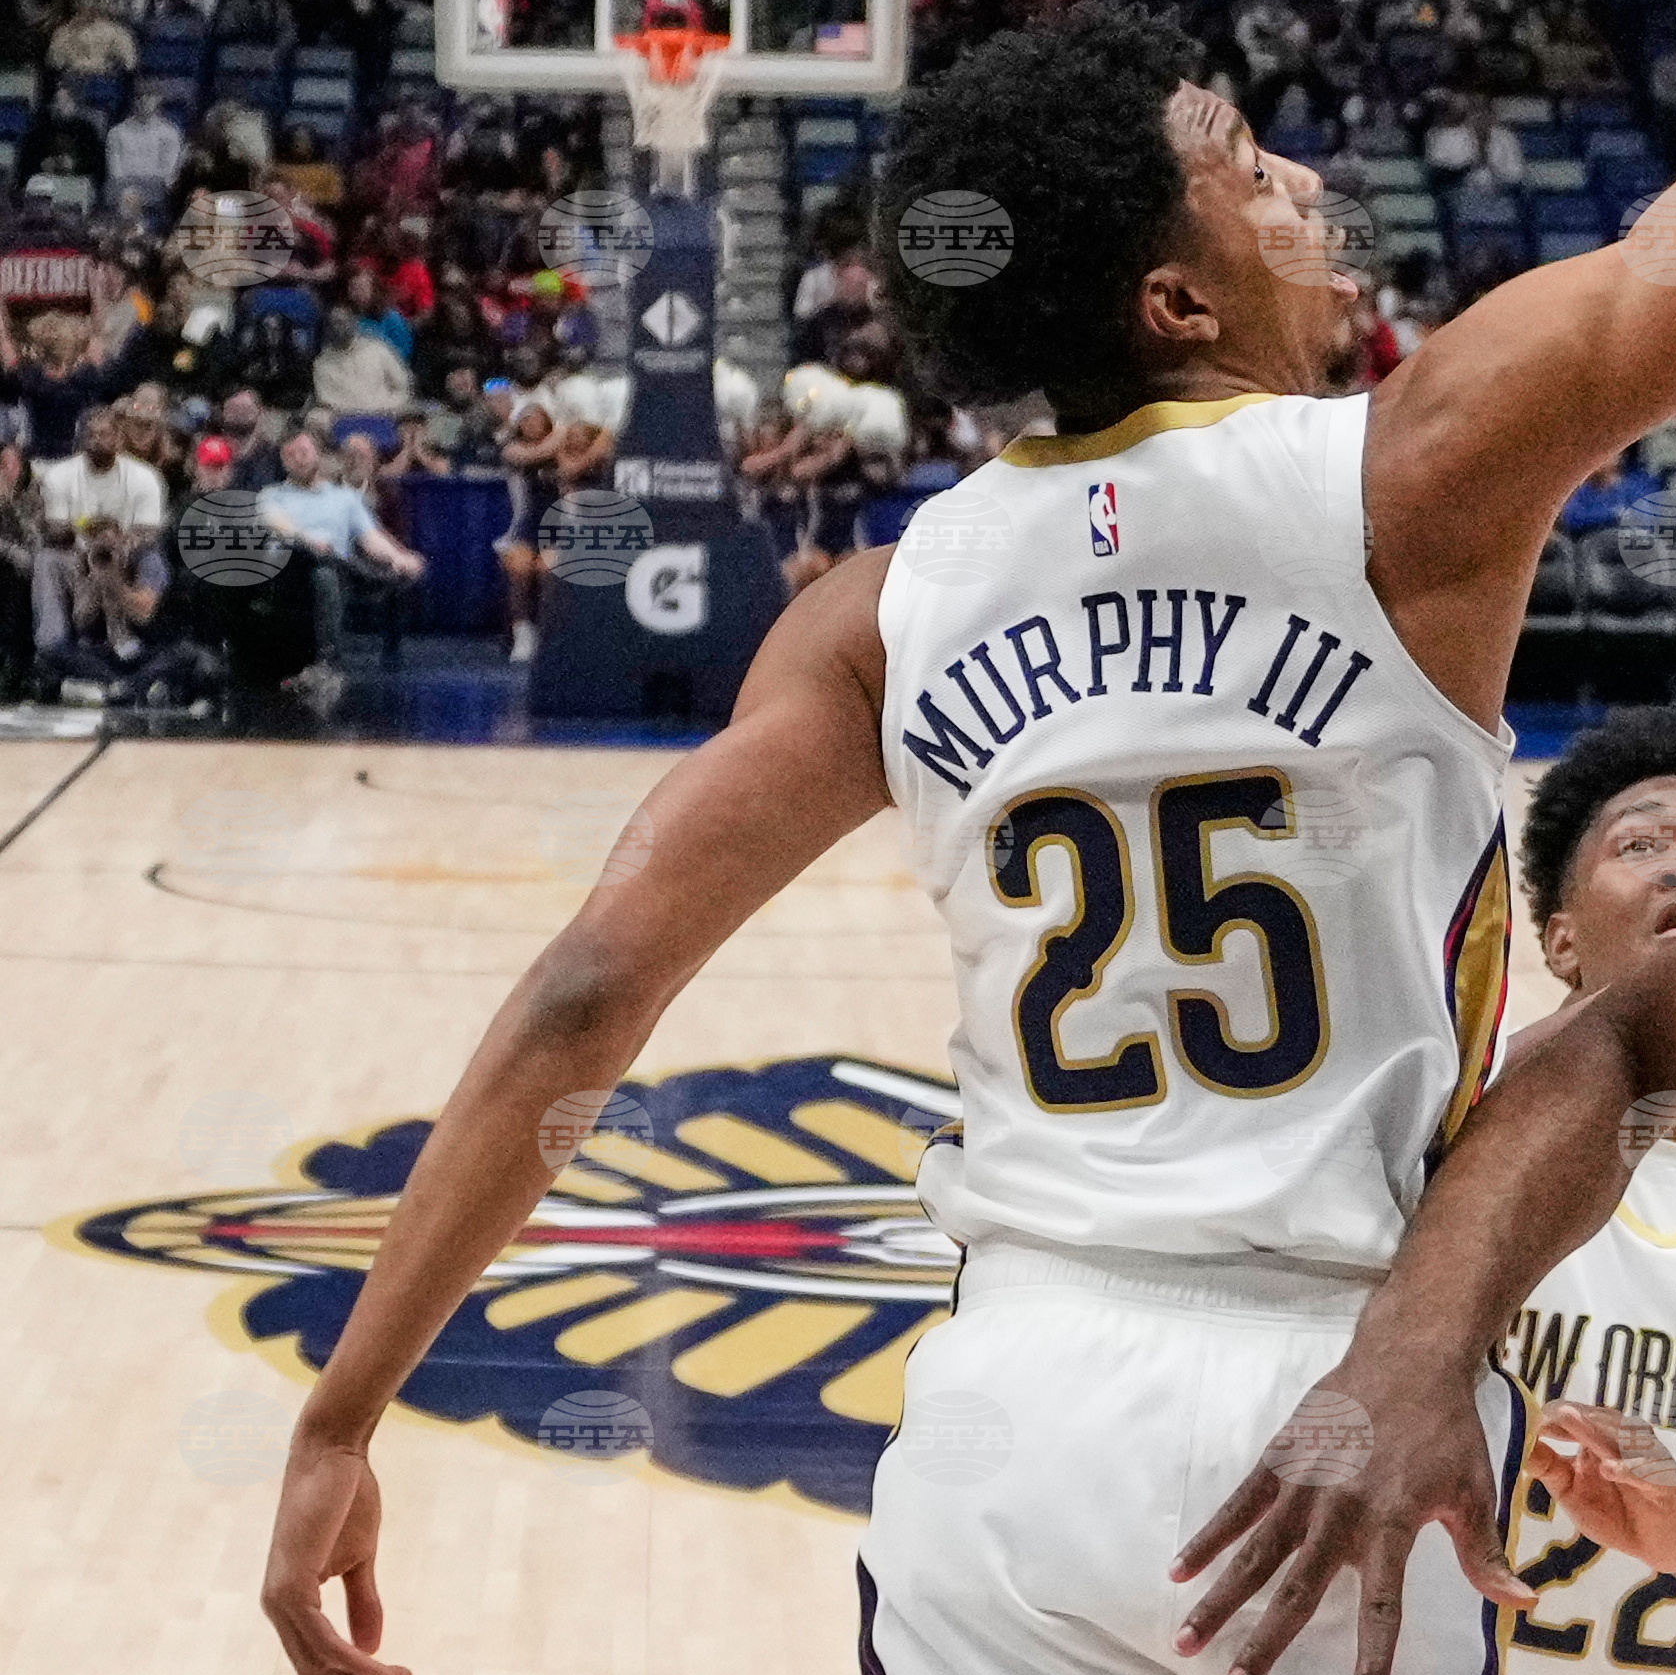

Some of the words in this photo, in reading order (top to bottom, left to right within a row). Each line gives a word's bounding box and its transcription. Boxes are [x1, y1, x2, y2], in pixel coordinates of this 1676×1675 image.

[902, 588, 1247, 801] MURPHY
[1246, 614, 1374, 749] III
[984, 764, 1332, 1115] 25
